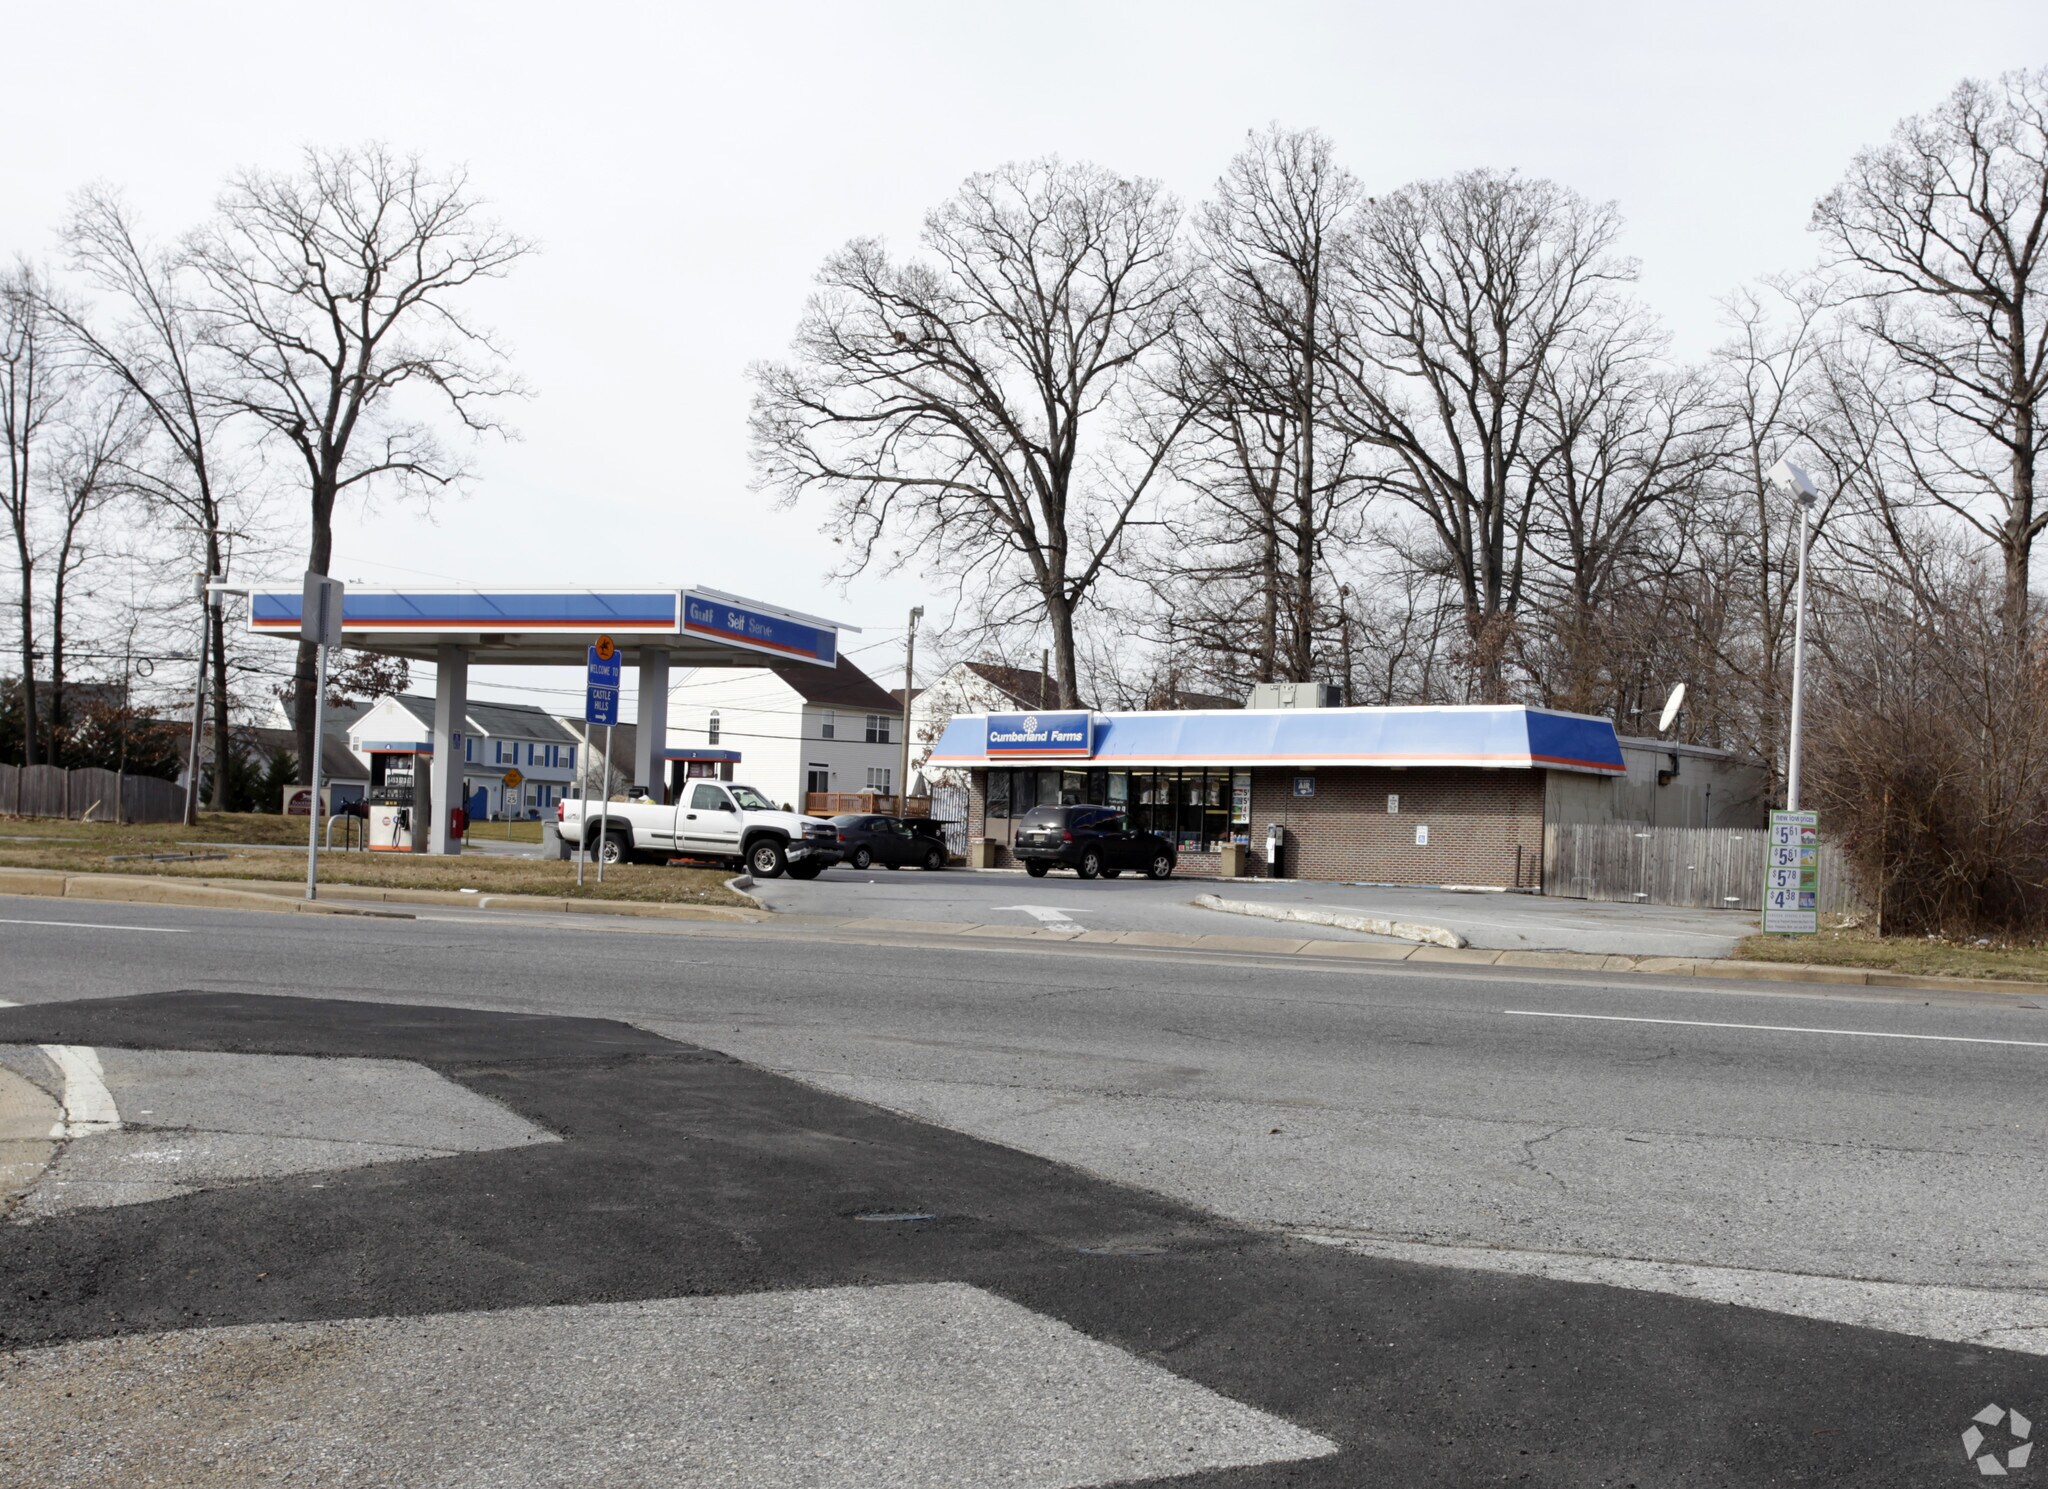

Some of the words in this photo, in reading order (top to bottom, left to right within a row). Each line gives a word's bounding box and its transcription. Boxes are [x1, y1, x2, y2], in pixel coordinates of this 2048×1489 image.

[690, 602, 714, 623] Gulf
[727, 612, 745, 631] Self
[590, 664, 610, 676] WELCOME
[612, 667, 618, 677] TO
[593, 689, 611, 700] CASTLE
[594, 701, 609, 711] HILLS
[990, 731, 1048, 742] Cumberland
[1051, 731, 1083, 742] Farms
